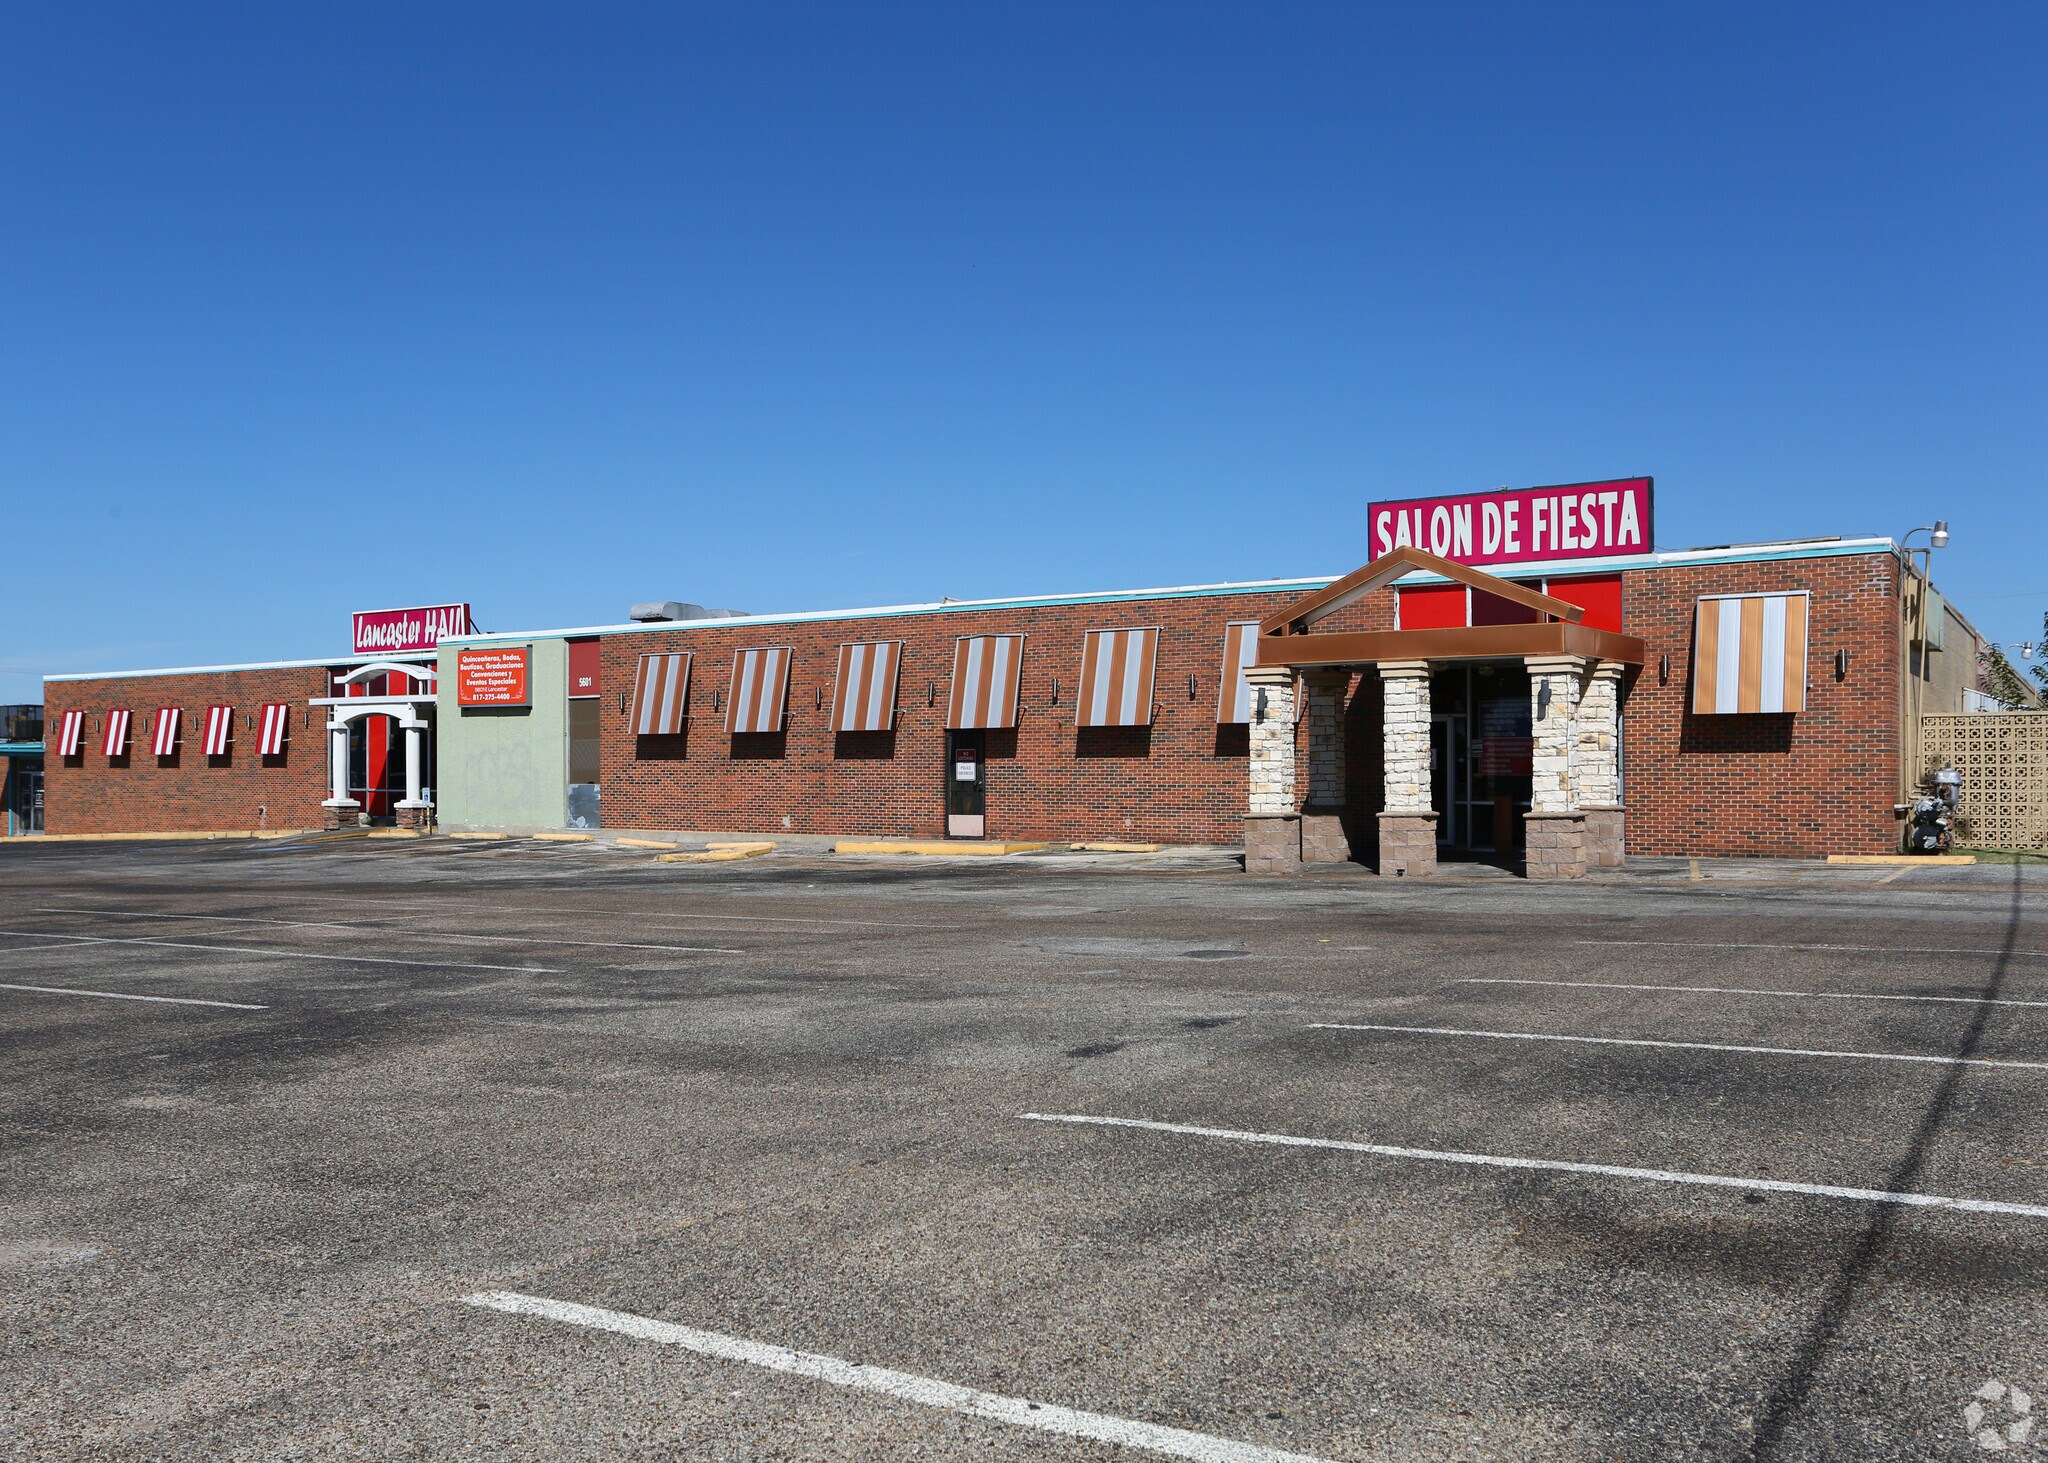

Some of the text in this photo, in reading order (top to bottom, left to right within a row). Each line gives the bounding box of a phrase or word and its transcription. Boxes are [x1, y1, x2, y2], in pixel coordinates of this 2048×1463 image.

[1376, 489, 1641, 559] SALON DE FIESTA
[356, 612, 420, 649] Lancaster
[579, 676, 592, 687] 5601
